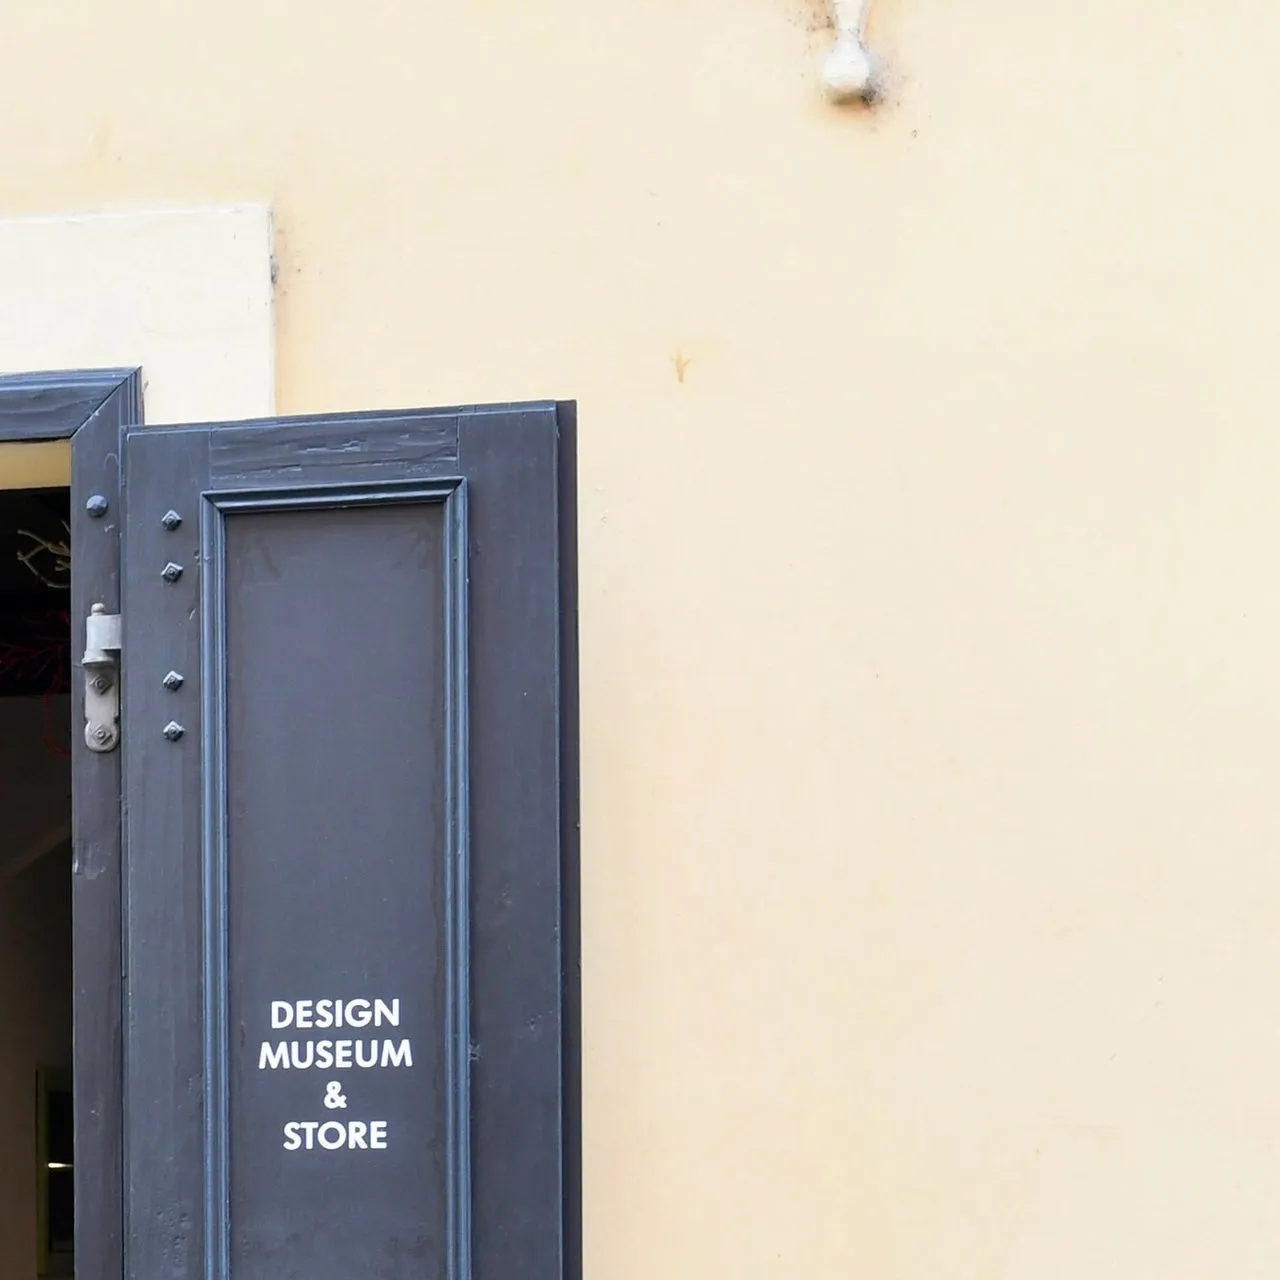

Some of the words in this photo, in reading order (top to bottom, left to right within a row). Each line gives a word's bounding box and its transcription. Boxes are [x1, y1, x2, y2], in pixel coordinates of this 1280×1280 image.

[271, 998, 400, 1029] DESIGN
[258, 1039, 413, 1070] MUSEUM
[323, 1080, 347, 1109] &
[283, 1120, 388, 1151] STORE
